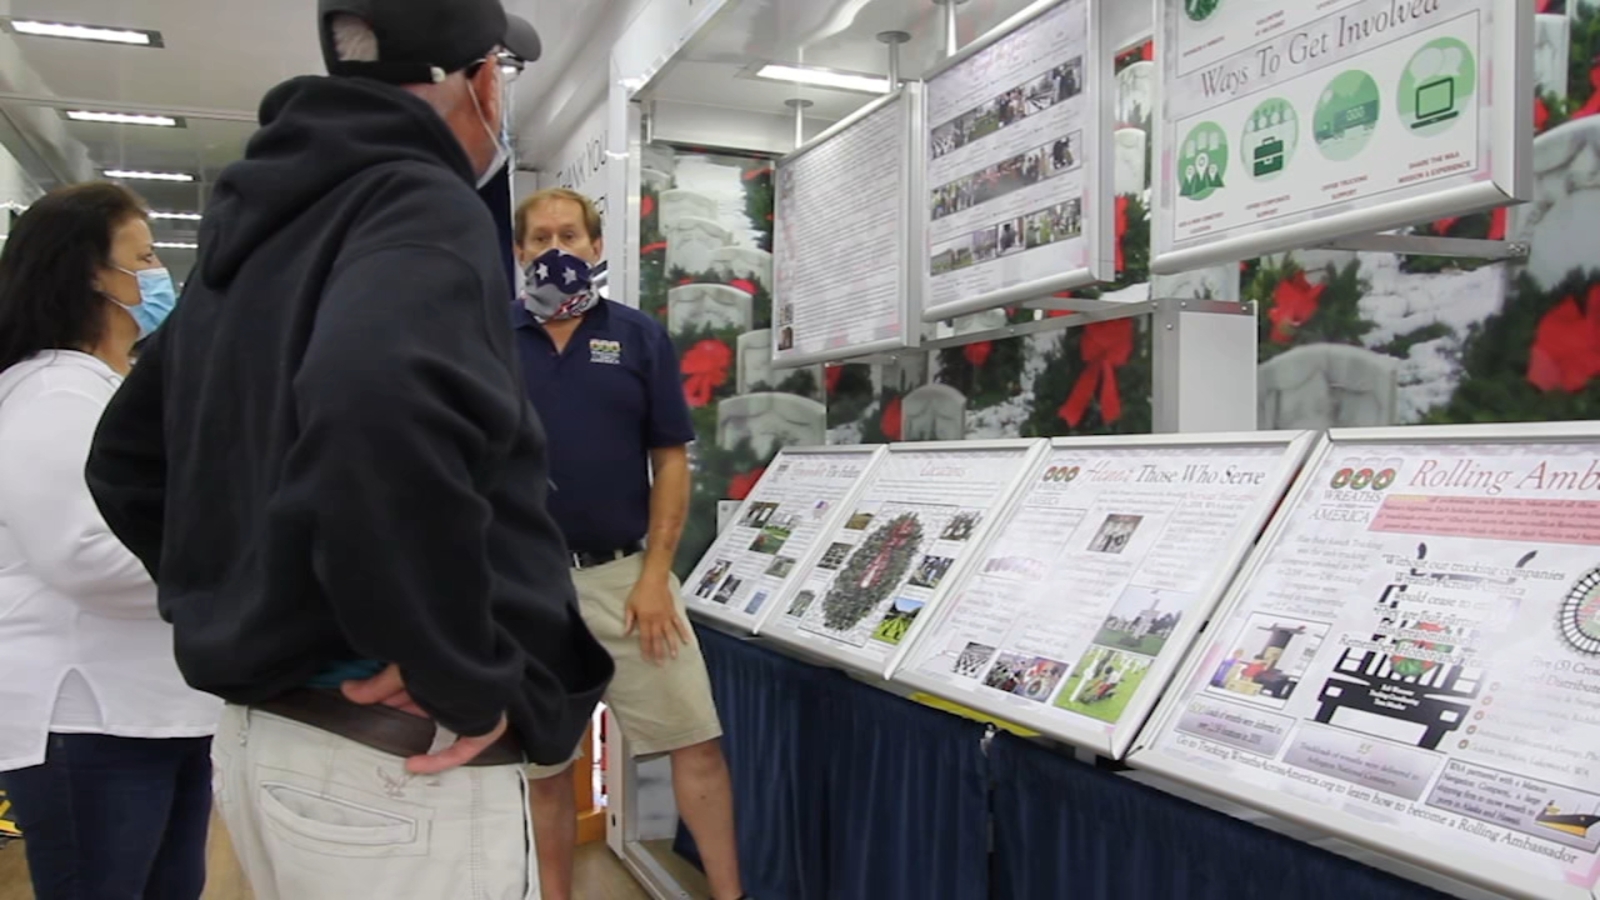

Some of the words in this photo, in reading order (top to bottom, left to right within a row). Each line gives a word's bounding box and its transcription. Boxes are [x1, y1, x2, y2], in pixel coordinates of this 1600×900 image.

[1201, 66, 1249, 97] Ways
[1256, 46, 1281, 78] To
[1289, 32, 1328, 65] Get
[1136, 464, 1179, 484] Those
[1181, 464, 1218, 485] Who
[1220, 464, 1266, 486] Serve
[1409, 459, 1513, 496] Rolling
[1515, 459, 1600, 491] Amb
[1324, 489, 1384, 502] WREATHS
[1308, 509, 1370, 523] AMERICA
[1382, 553, 1428, 570] "Without
[1429, 559, 1449, 571] our
[1449, 561, 1498, 578] trucking
[1500, 566, 1566, 581] companies
[1176, 735, 1188, 747] Go
[1347, 785, 1371, 801] learn
[1371, 791, 1394, 808] how
[1406, 804, 1448, 825] become
[1457, 817, 1501, 843] Rolling
[1500, 832, 1580, 865] Ambassador
